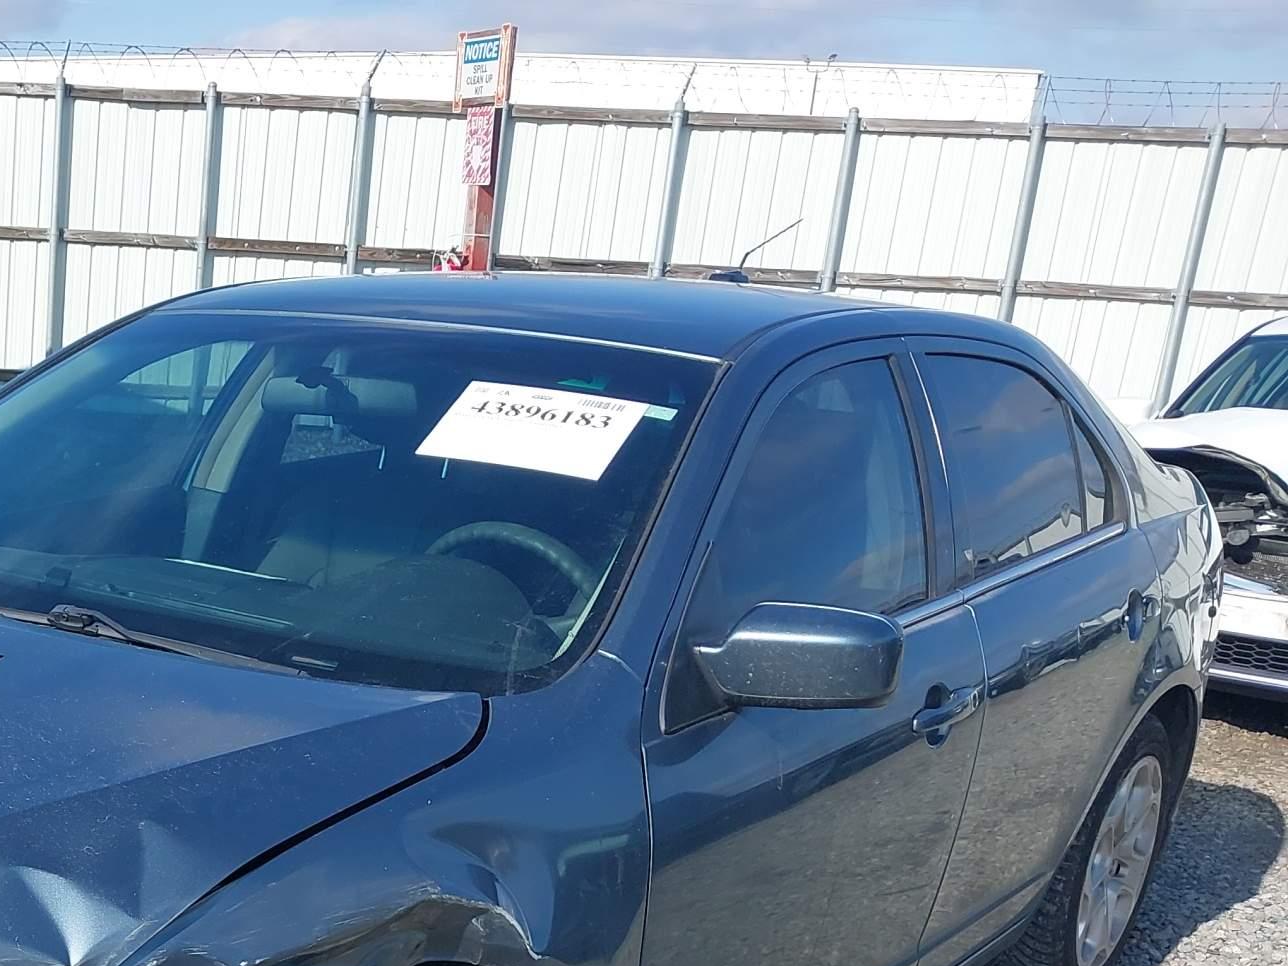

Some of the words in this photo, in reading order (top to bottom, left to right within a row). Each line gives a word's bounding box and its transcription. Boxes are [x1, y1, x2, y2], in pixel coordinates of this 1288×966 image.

[465, 41, 499, 60] NOTICE
[473, 64, 488, 74] SPILL
[466, 75, 484, 85] CLEAN
[485, 74, 493, 84] UP
[474, 86, 484, 95] KIT
[471, 116, 489, 128] FIRE
[471, 400, 612, 428] 43896183
